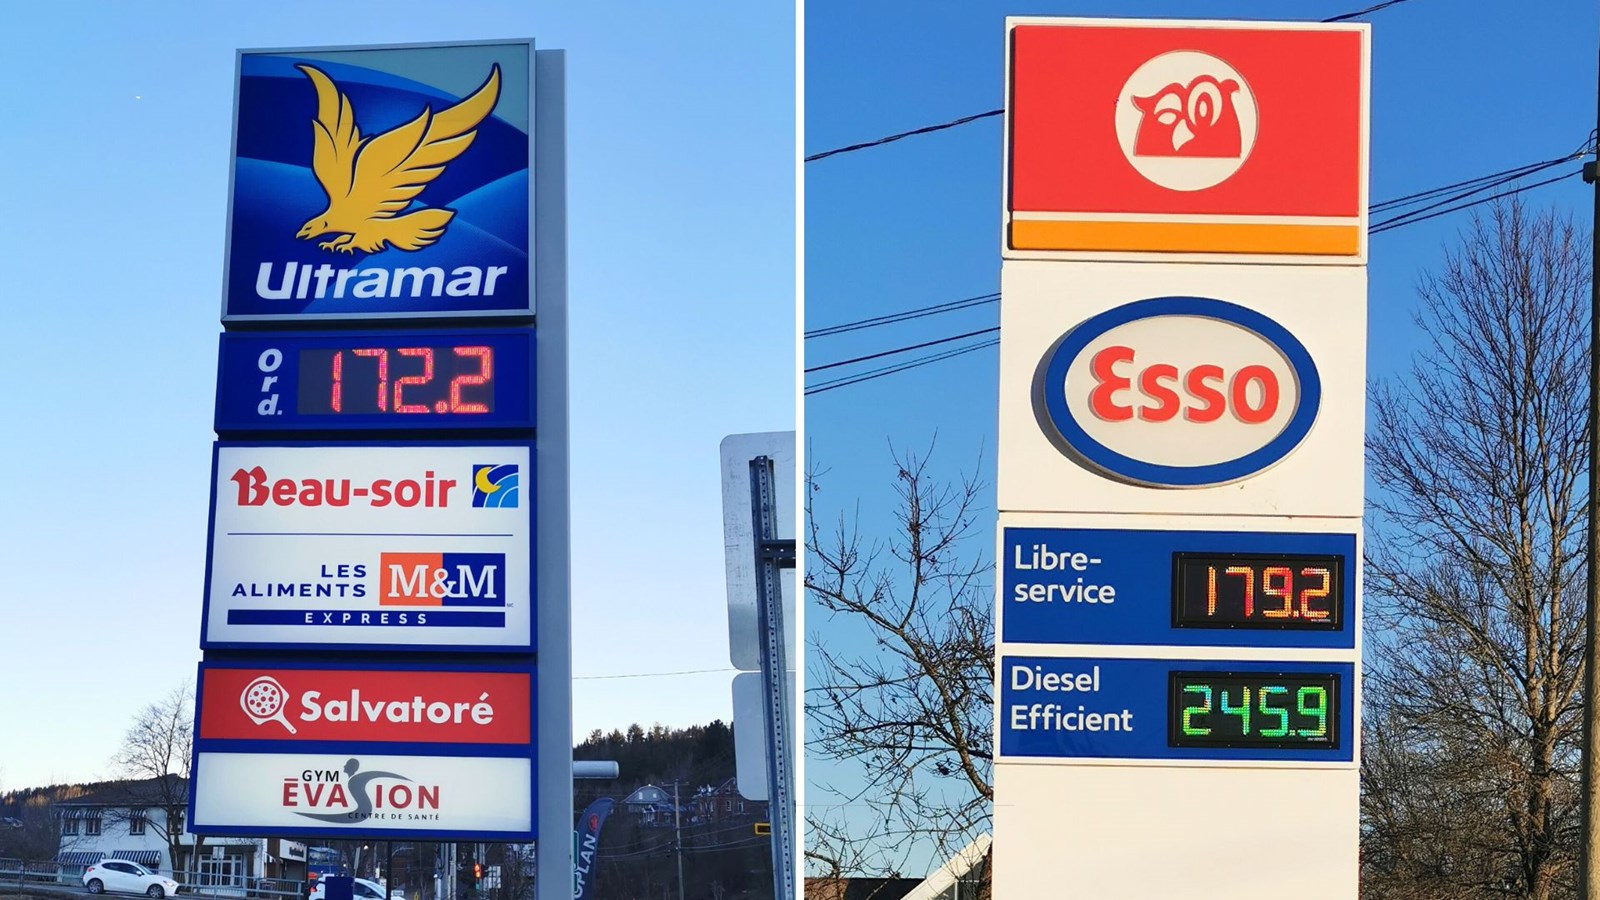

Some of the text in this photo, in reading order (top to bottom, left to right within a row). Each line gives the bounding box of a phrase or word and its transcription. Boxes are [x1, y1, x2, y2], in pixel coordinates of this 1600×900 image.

[255, 261, 508, 300] Ultramar
[331, 345, 492, 413] 172.2
[1087, 345, 1280, 425] Esso
[230, 465, 457, 508] Beau-soir
[321, 564, 367, 578] LES
[1014, 544, 1102, 571] Libre-
[231, 583, 367, 598] ALIMENTS
[387, 563, 497, 599] M&M
[1014, 577, 1116, 604] service
[1206, 565, 1331, 618] 179.2
[304, 612, 428, 625] EXPRESS
[1011, 665, 1100, 692] Diesel
[299, 688, 494, 726] Salvatoré
[1010, 703, 1134, 732] Efficient
[1182, 684, 1328, 737] 245.9
[302, 769, 340, 783] GYM
[347, 812, 386, 820] CENTRE
[408, 813, 440, 821] SANTÉ
